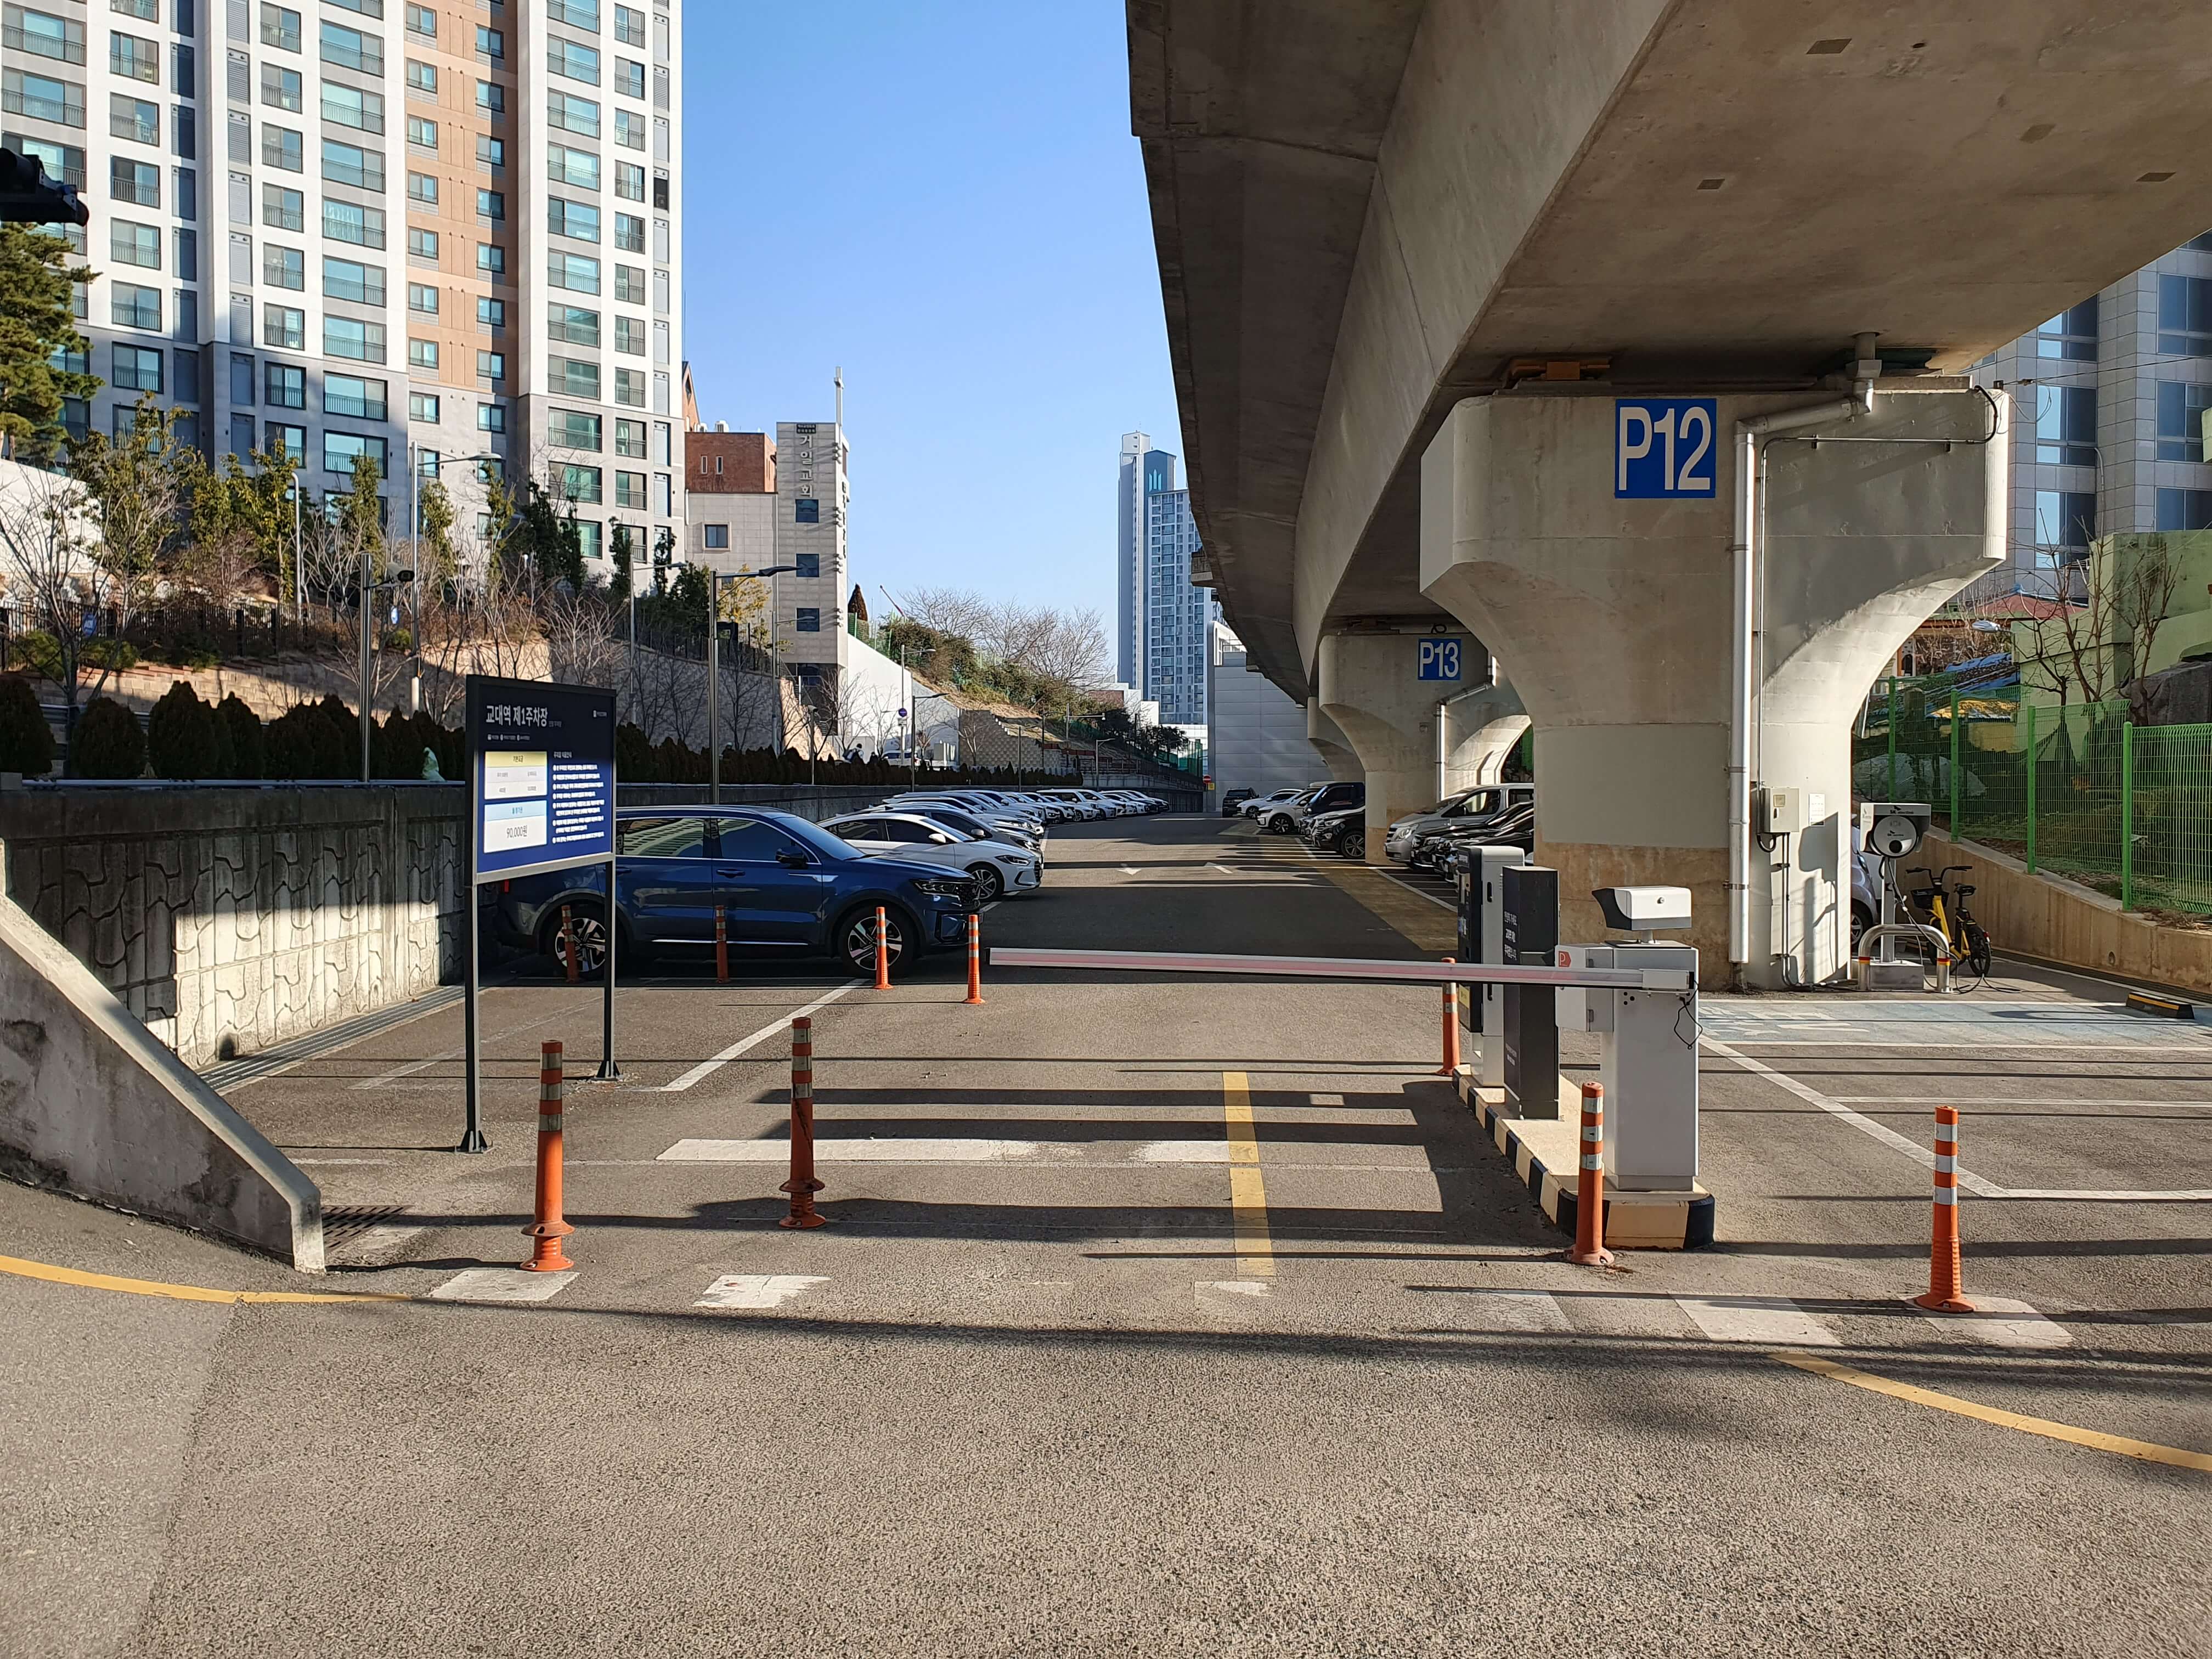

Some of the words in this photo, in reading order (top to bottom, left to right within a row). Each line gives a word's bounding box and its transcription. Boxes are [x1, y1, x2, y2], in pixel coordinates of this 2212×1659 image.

[799, 435, 813, 498] 거일교회
[1619, 407, 1711, 490] P12
[1419, 642, 1459, 678] P13
[486, 704, 511, 726] 교대역
[513, 706, 548, 727] 제1주차장
[506, 825, 528, 838] 90,000원
